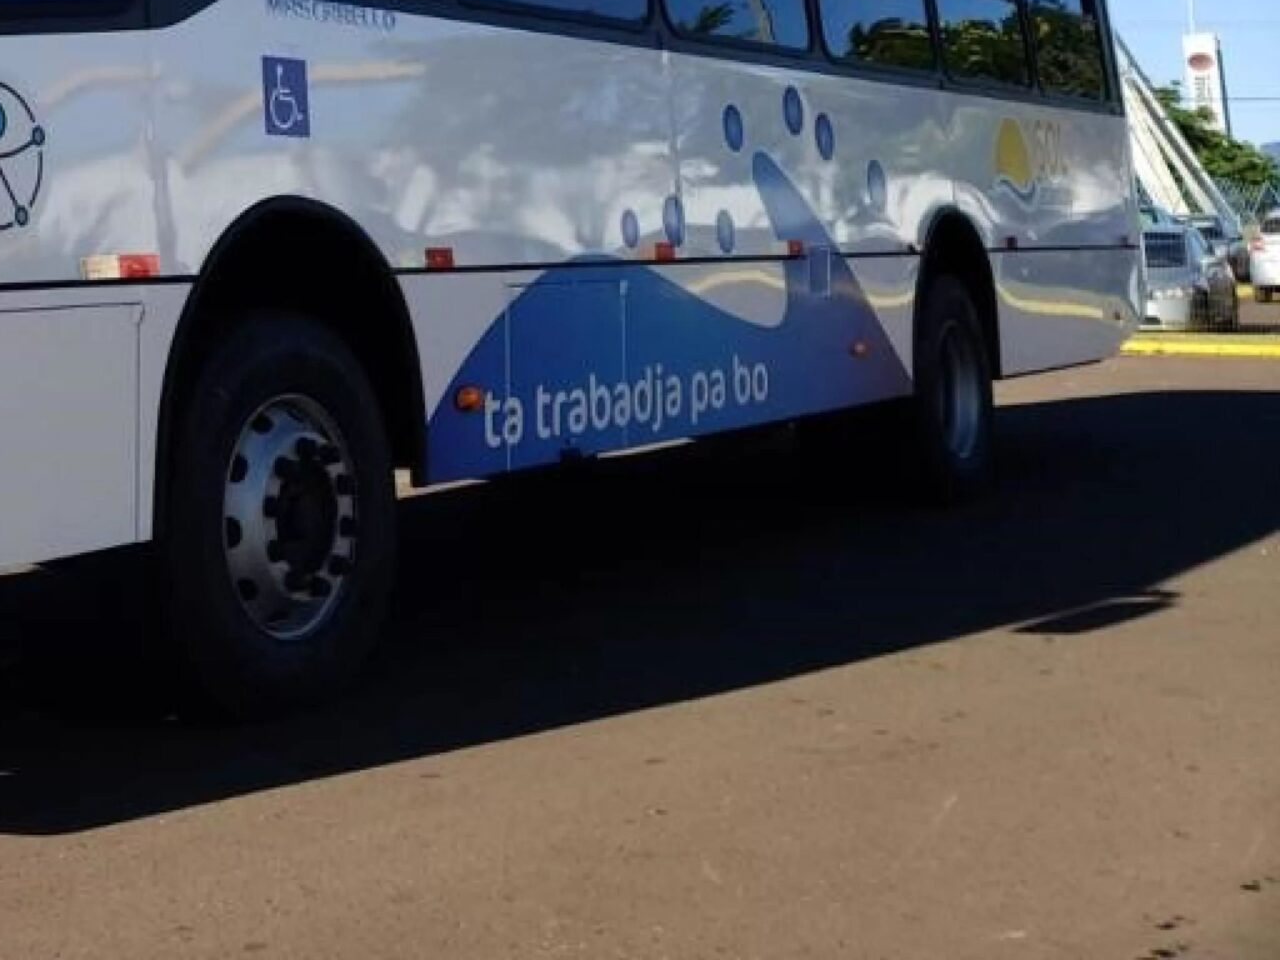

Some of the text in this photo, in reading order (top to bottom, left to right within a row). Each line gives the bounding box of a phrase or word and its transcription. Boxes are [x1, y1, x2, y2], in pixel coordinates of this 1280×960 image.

[483, 354, 768, 448] ta trabadja pa bo
